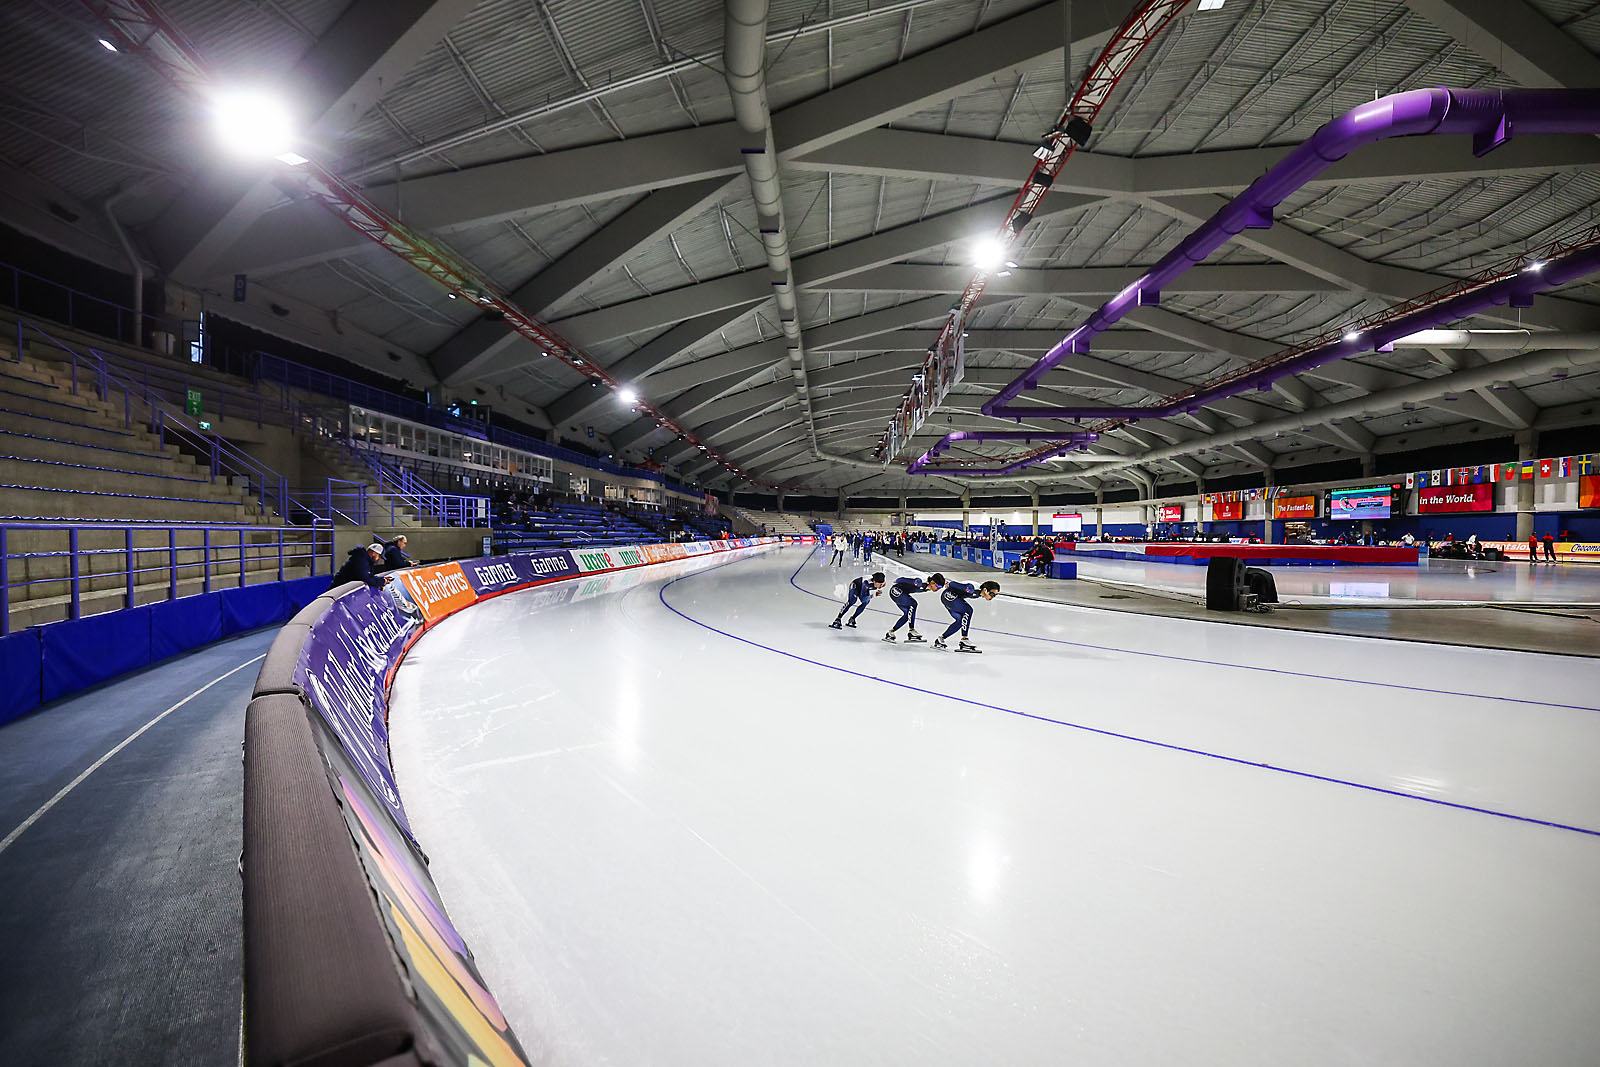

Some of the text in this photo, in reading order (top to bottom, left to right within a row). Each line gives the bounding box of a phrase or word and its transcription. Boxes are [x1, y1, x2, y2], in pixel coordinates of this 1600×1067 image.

[188, 389, 201, 402] EXIT
[1277, 502, 1314, 512] The Fastest Ice
[1419, 493, 1476, 505] in the World.
[415, 571, 469, 604] EuroParcs
[961, 612, 970, 632] KOR
[322, 630, 378, 756] Holland
[365, 602, 402, 646] Line
